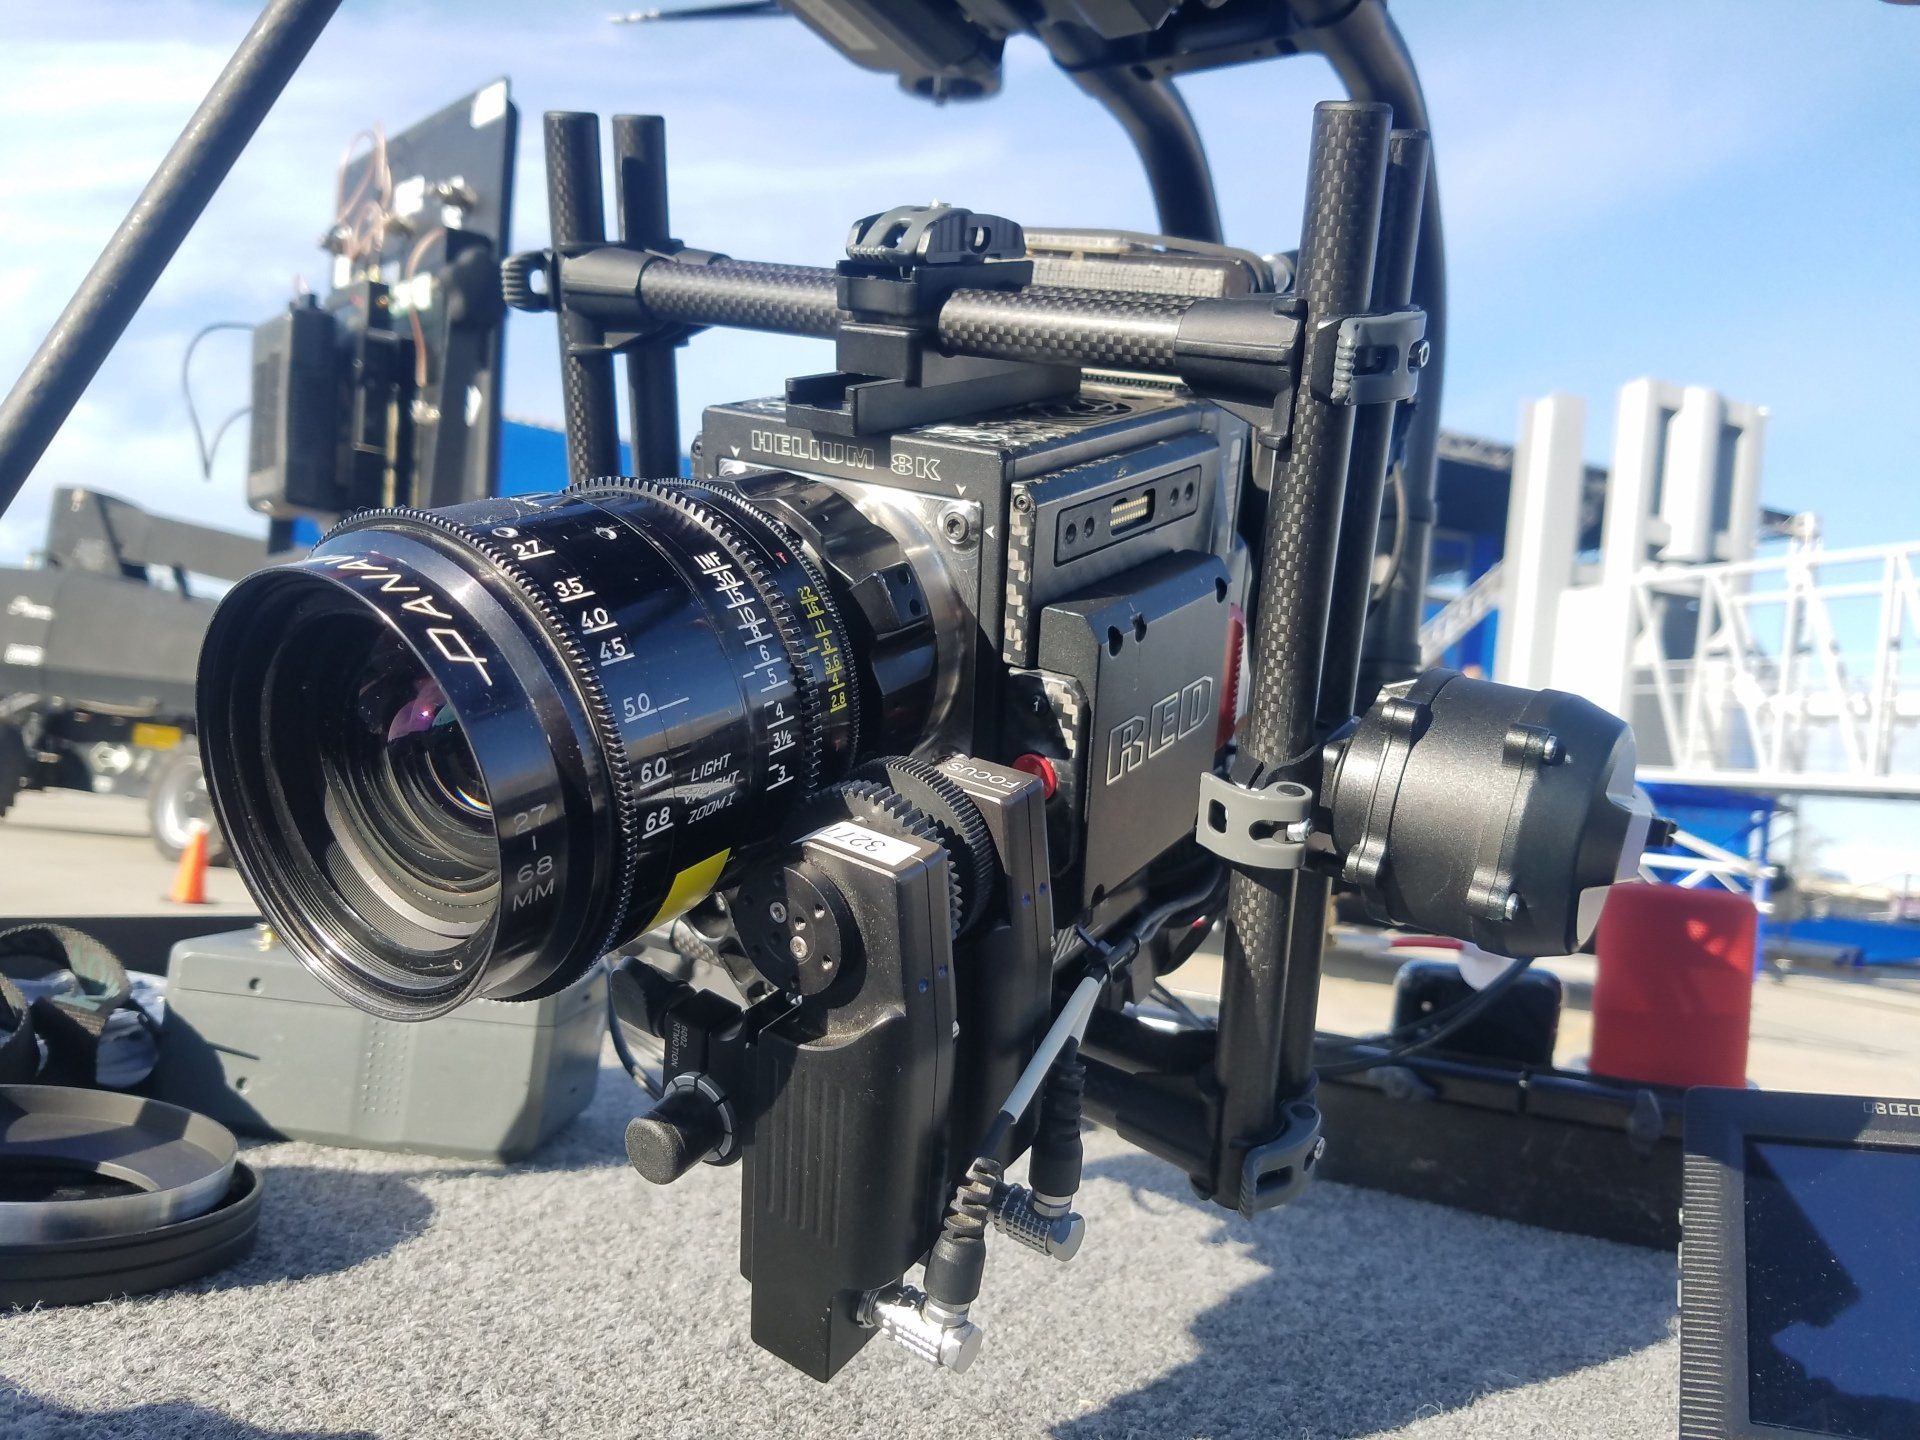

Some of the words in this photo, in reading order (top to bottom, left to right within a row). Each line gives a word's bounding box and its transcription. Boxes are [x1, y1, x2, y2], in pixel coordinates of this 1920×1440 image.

[750, 429, 875, 471] HELIUM
[890, 453, 942, 481] 8K
[512, 540, 540, 557] 27
[693, 551, 722, 570] INF
[553, 577, 585, 598] 35
[712, 571, 737, 588] 30
[726, 588, 745, 604] 15
[797, 586, 815, 600] 22
[737, 607, 756, 625] 10
[806, 601, 820, 615] 16
[581, 607, 610, 629] 40
[814, 618, 827, 634] 11
[750, 625, 762, 641] 8
[599, 637, 627, 661] 45
[759, 645, 771, 661] 6
[822, 638, 832, 651] 8
[824, 654, 840, 671] 5.6
[767, 668, 778, 685] 5
[832, 672, 840, 685] 4
[623, 692, 651, 718] 50
[830, 691, 846, 708] 2.8
[775, 702, 785, 719] 4
[1105, 675, 1214, 786] RED
[641, 757, 667, 783] 60
[690, 753, 732, 782] LIGHT
[777, 766, 786, 782] 3
[946, 761, 1023, 789] FOCUS
[513, 803, 548, 836] 27
[645, 806, 671, 832] 68
[687, 796, 728, 825] ZOOM
[820, 827, 886, 852] 3277
[517, 855, 553, 883] 68
[512, 878, 555, 912] MM
